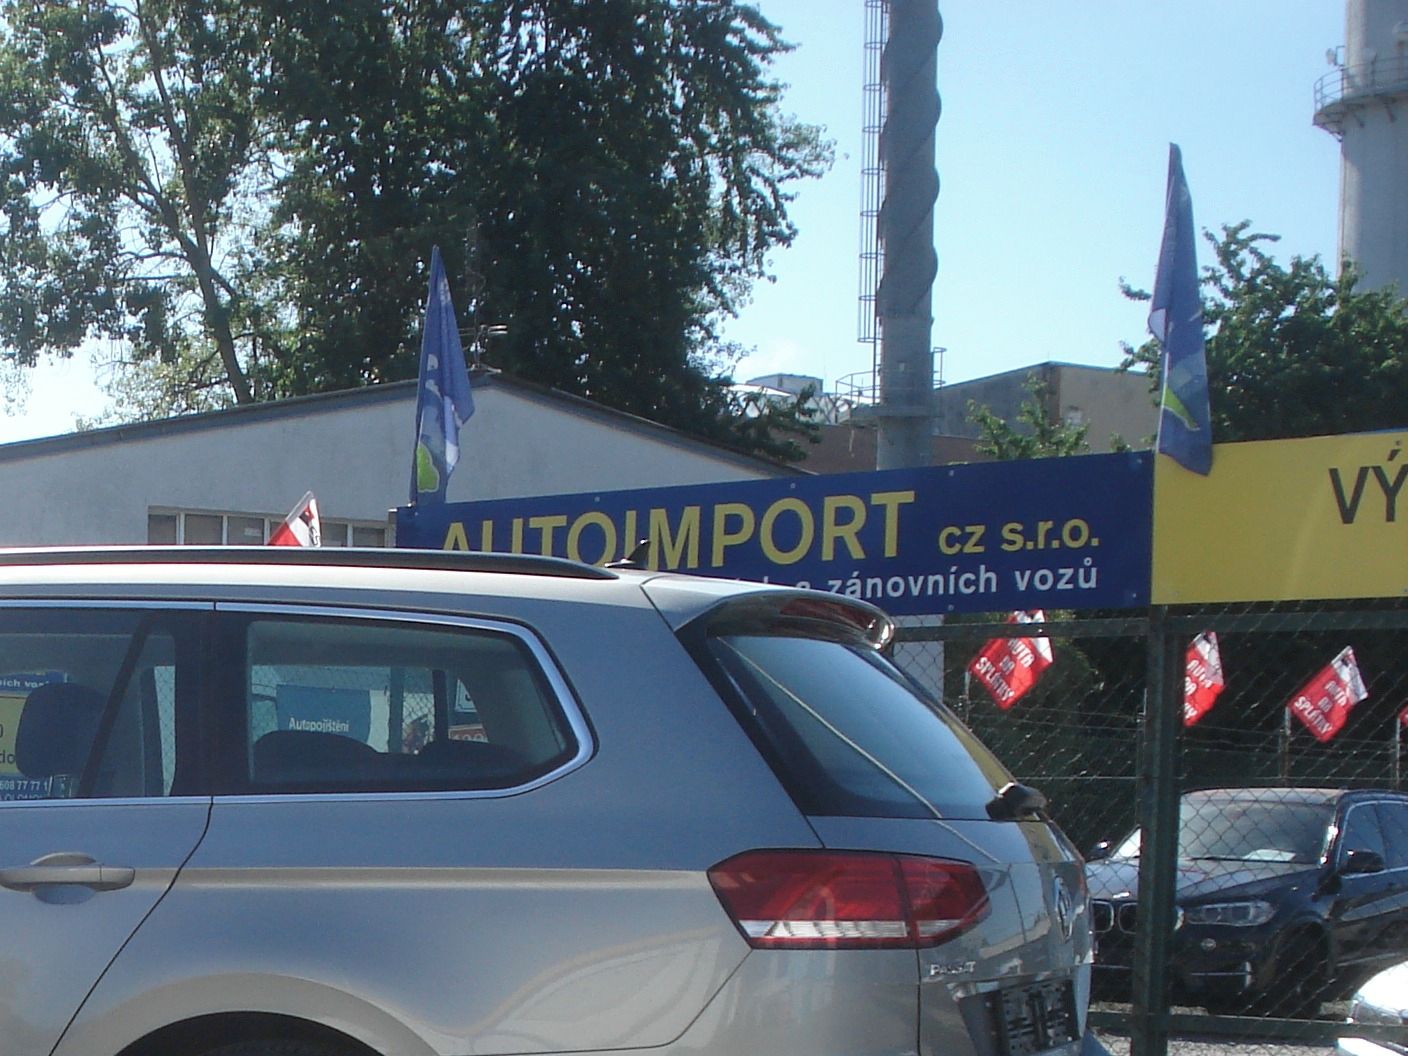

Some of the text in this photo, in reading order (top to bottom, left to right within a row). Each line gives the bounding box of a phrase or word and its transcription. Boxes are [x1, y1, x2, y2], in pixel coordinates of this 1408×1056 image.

[1328, 449, 1408, 524] VÝ
[938, 524, 985, 556] cz
[1000, 518, 1100, 552] s.r.o.
[1014, 556, 1097, 592] vozů
